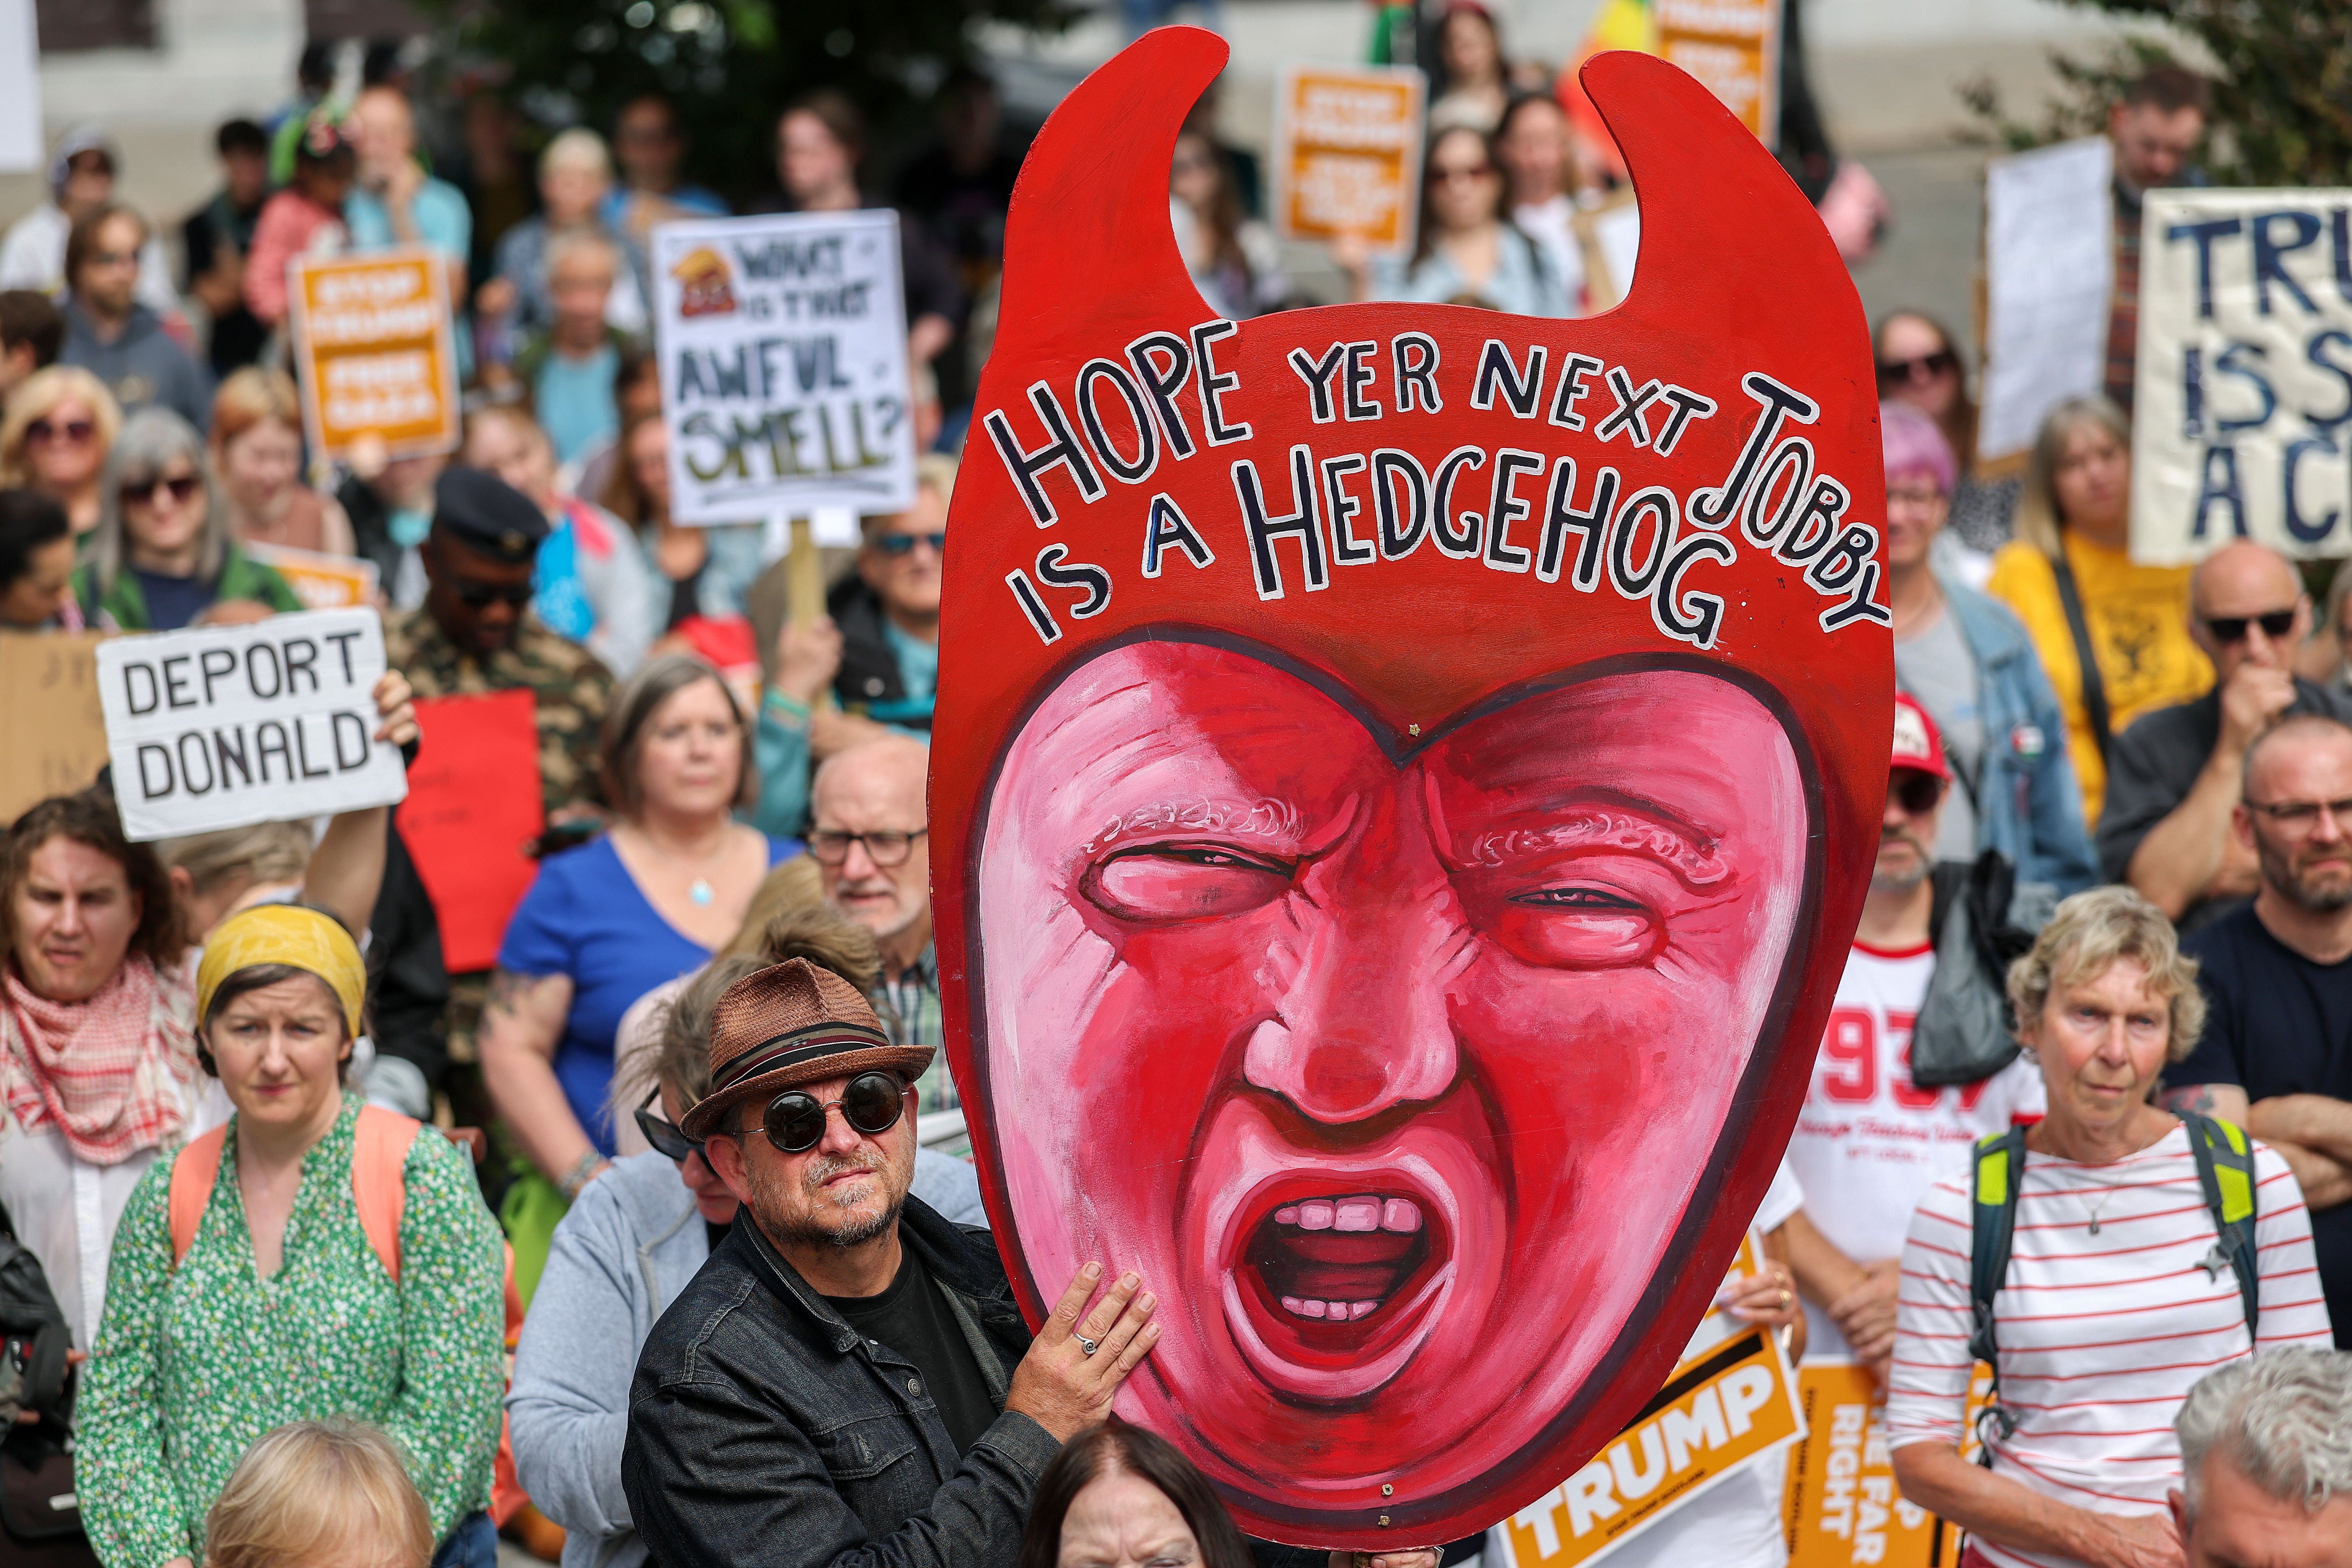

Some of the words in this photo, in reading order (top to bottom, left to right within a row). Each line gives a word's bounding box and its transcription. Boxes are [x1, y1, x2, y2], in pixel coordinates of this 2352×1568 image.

[737, 236, 845, 282] WHAT
[678, 336, 852, 401] AWFUL
[2183, 343, 2277, 441] IS
[682, 395, 903, 483] SMELL?
[983, 318, 1253, 529] HOPE
[1287, 331, 1443, 424] YER
[1470, 339, 1718, 456] NEXT
[1685, 371, 1892, 632] JOBBY
[2190, 444, 2249, 541] A
[1005, 543, 1113, 646] IS
[1141, 492, 1215, 578] A
[1230, 444, 1737, 650] HEDGEHOG
[123, 630, 363, 716] DEPORT
[137, 711, 369, 800] DONALD
[1512, 1363, 1776, 1560] TRUMP
[1819, 1404, 1867, 1540] RIGHT
[1850, 1476, 1893, 1566] FAR
